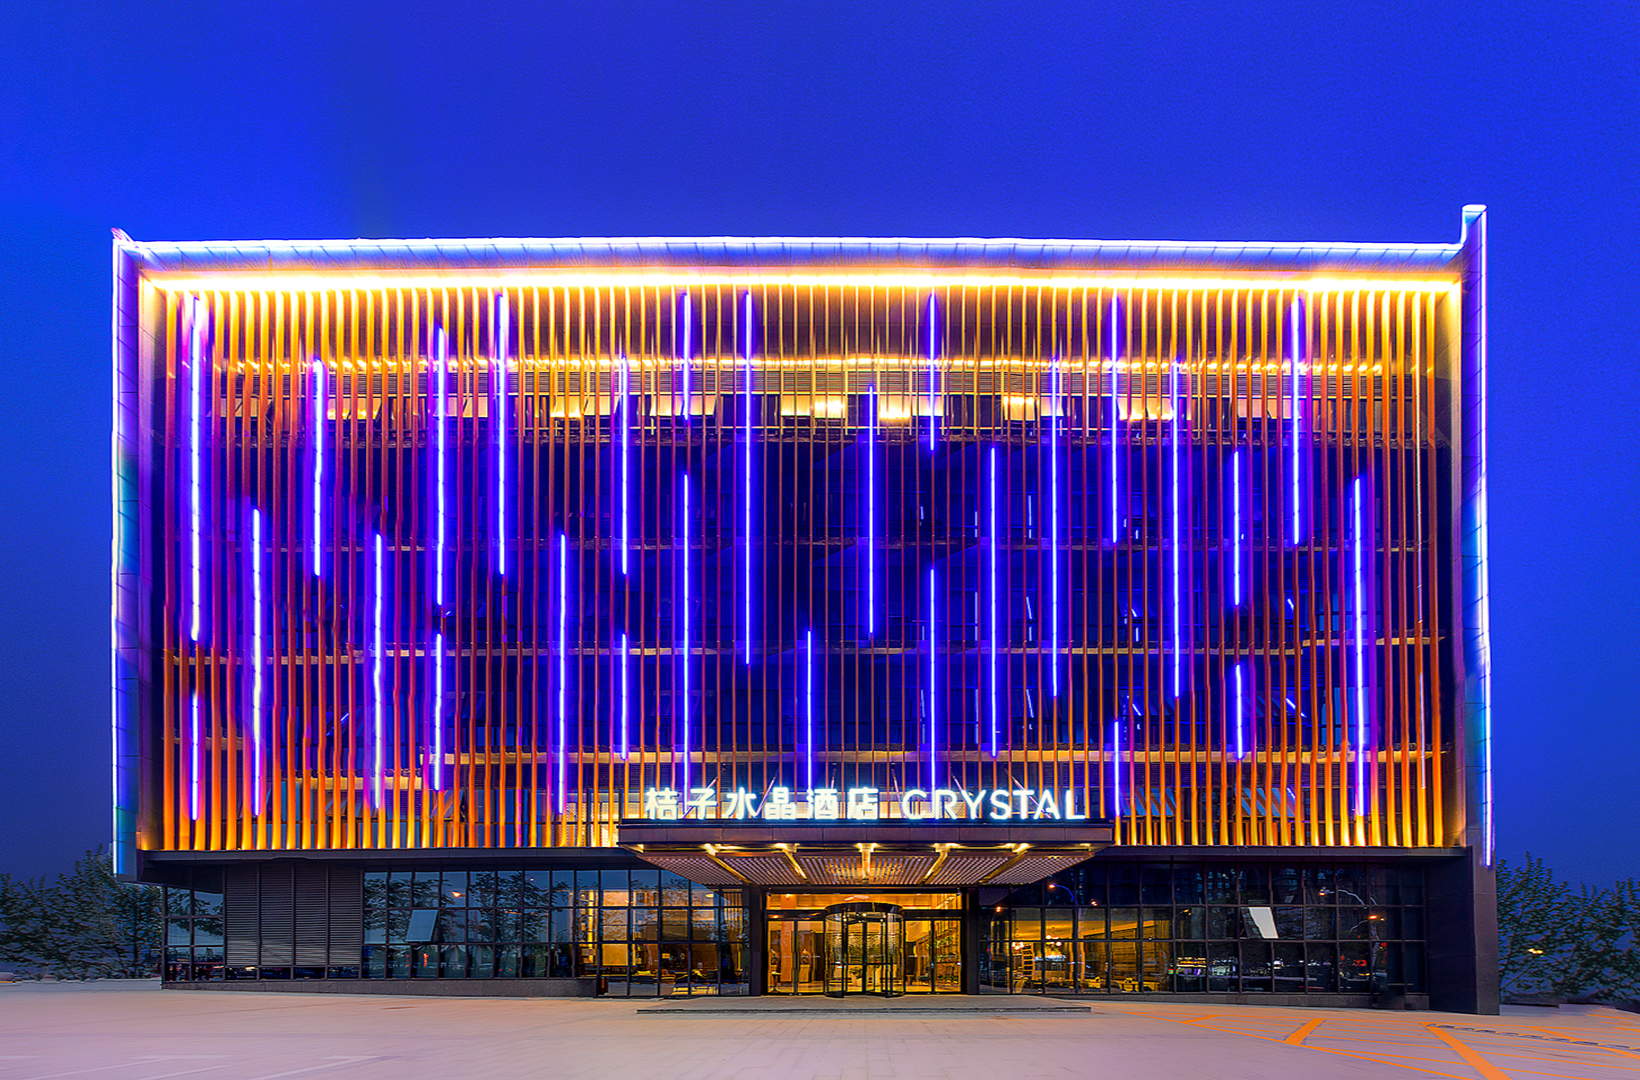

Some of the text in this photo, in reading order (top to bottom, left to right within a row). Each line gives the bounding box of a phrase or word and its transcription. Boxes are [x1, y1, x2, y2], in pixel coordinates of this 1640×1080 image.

[645, 787, 1086, 820] 桔子水晶酒店 CRYSTAL
